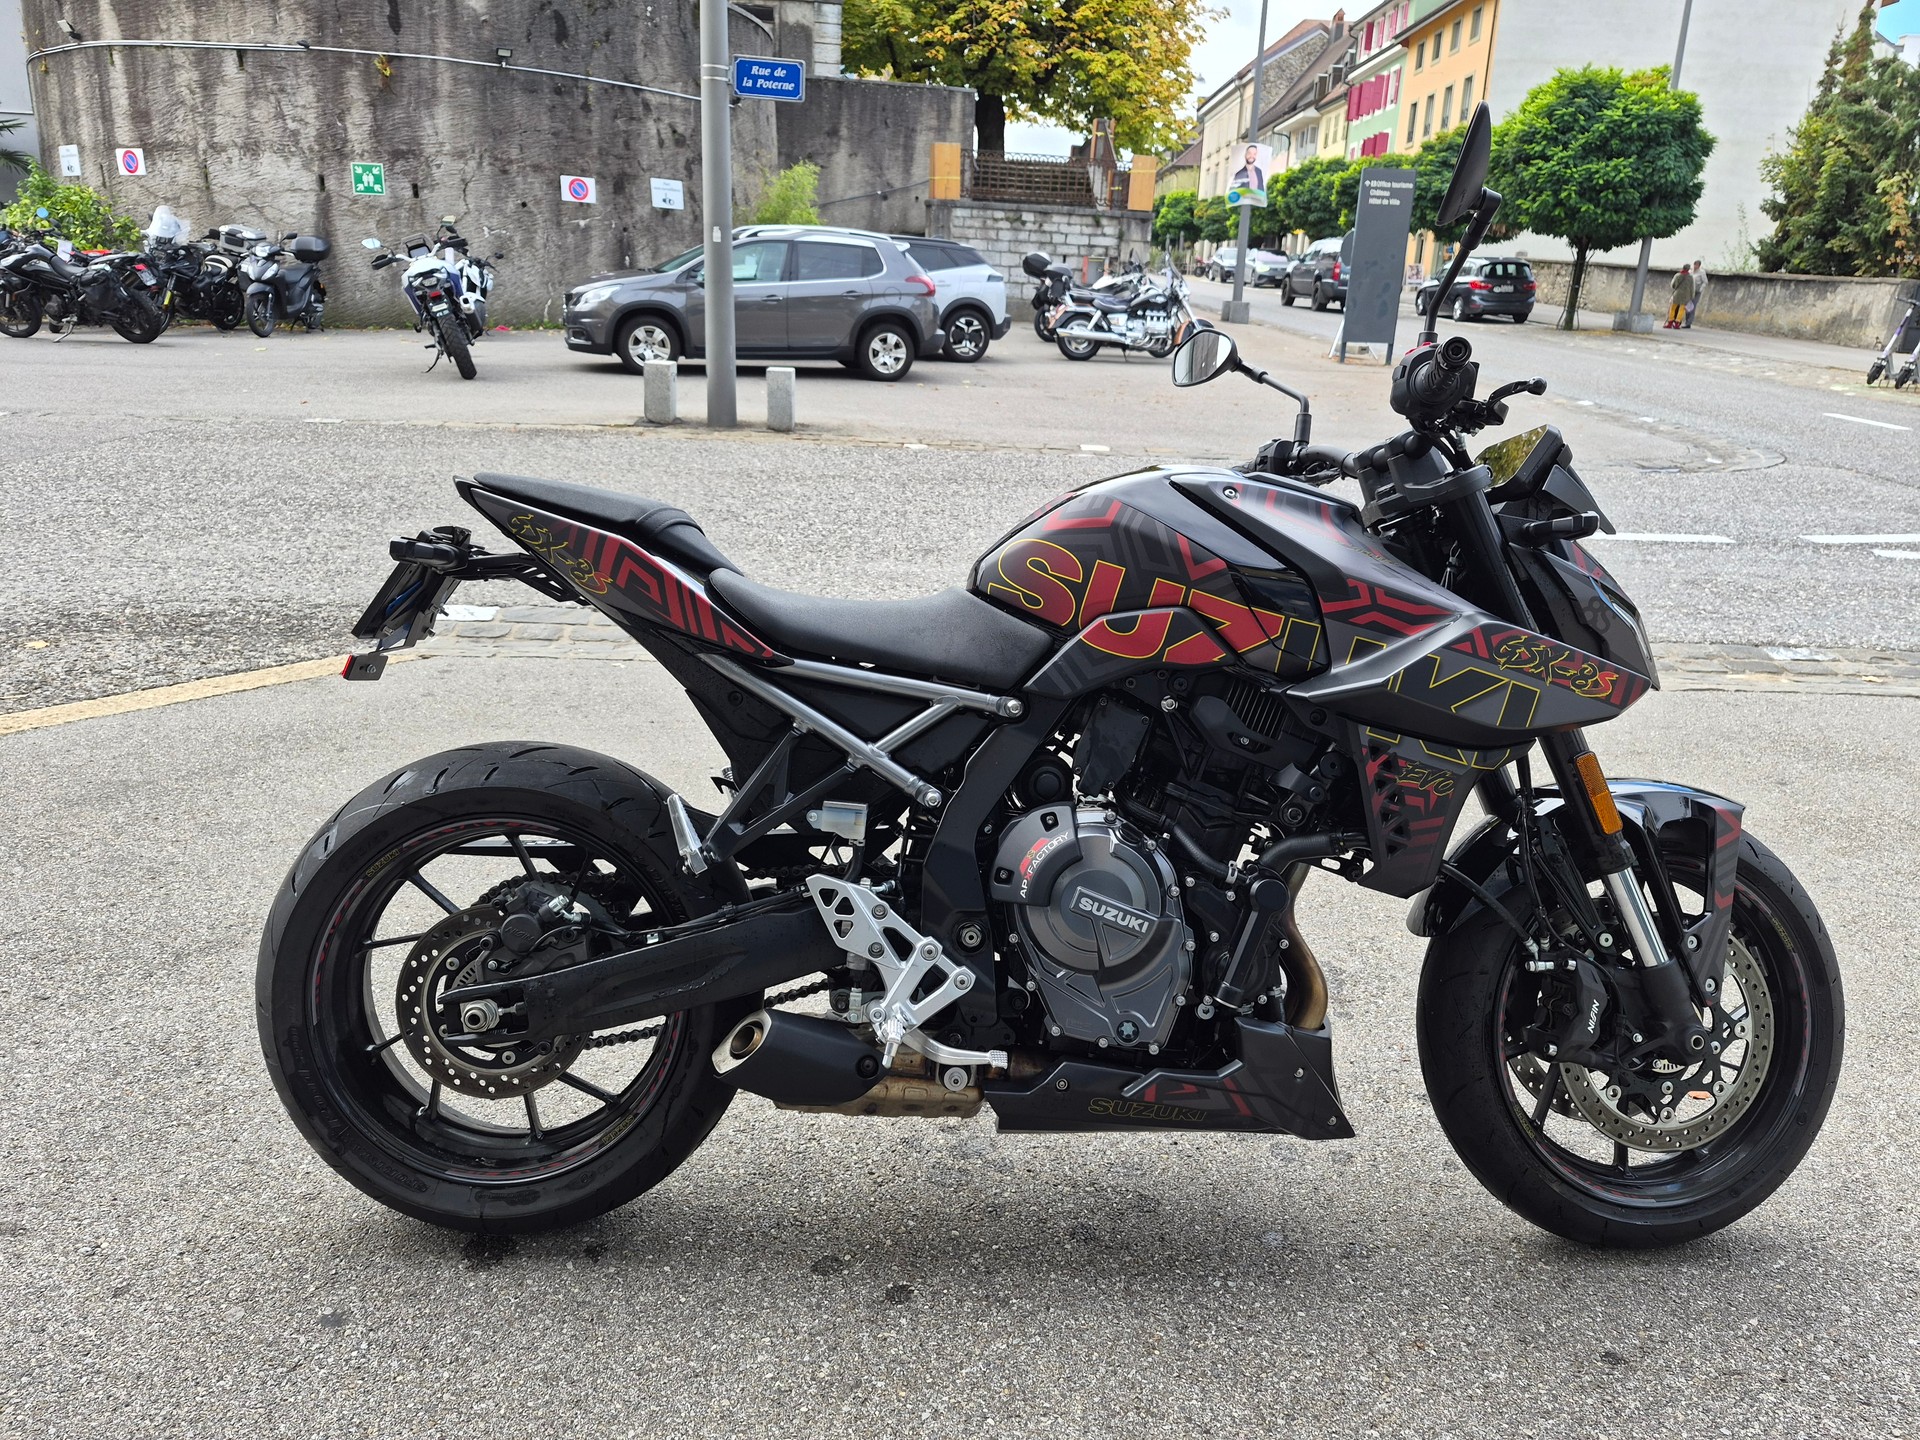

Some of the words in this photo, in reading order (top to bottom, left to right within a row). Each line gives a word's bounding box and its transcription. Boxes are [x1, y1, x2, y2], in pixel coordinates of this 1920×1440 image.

[750, 65, 771, 76] Rue
[773, 67, 787, 77] de
[742, 77, 753, 87] la
[756, 79, 795, 91] Poterne
[1078, 897, 1149, 933] SUZUKI
[1088, 1097, 1207, 1121] SUZUKI
